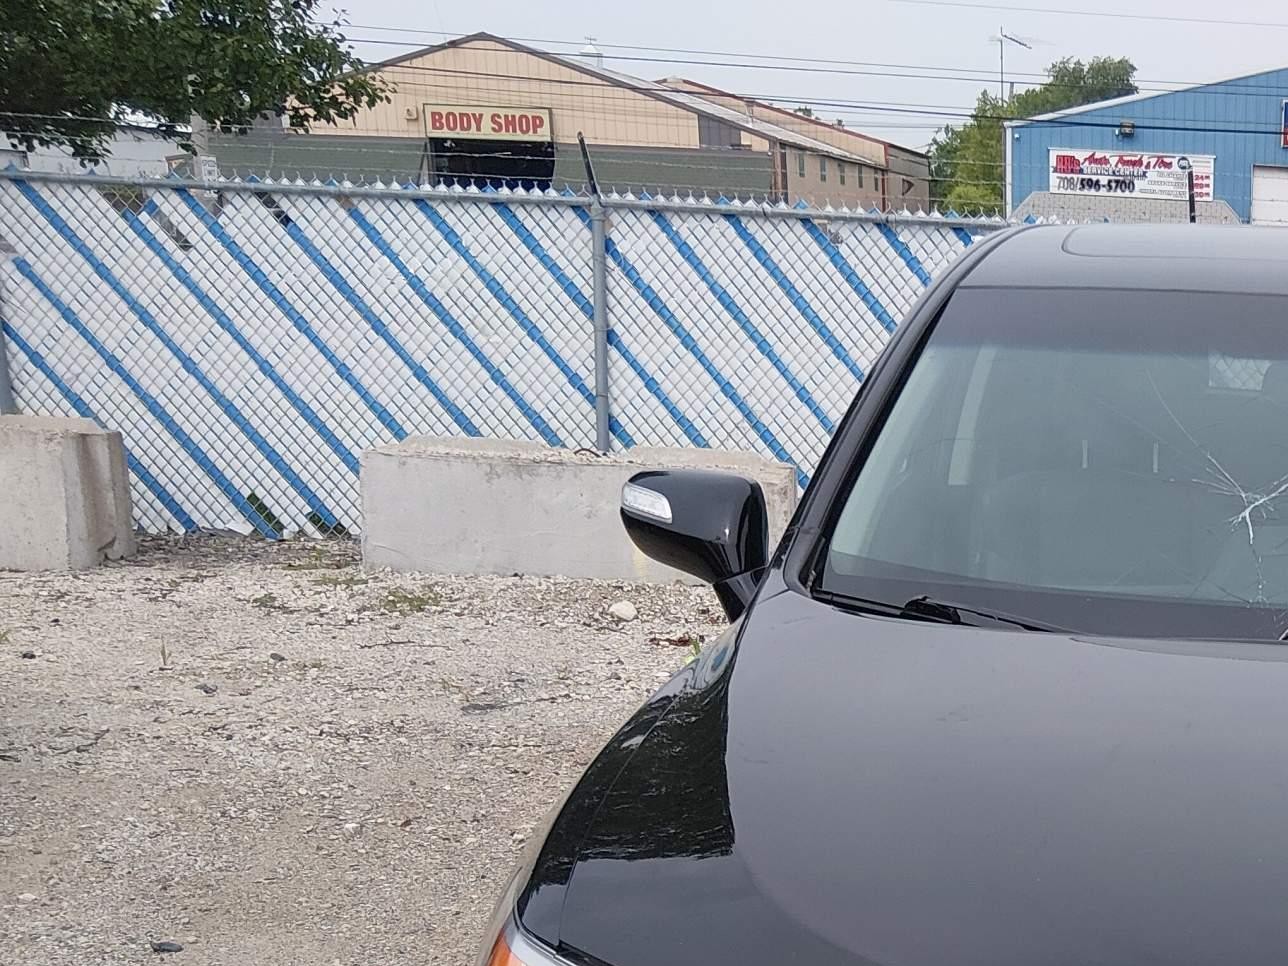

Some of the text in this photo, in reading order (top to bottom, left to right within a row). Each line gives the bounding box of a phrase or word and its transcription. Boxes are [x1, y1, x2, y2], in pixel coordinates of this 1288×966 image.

[430, 111, 544, 134] BODY SHOP
[1083, 166, 1144, 177] SERVICE CENTER
